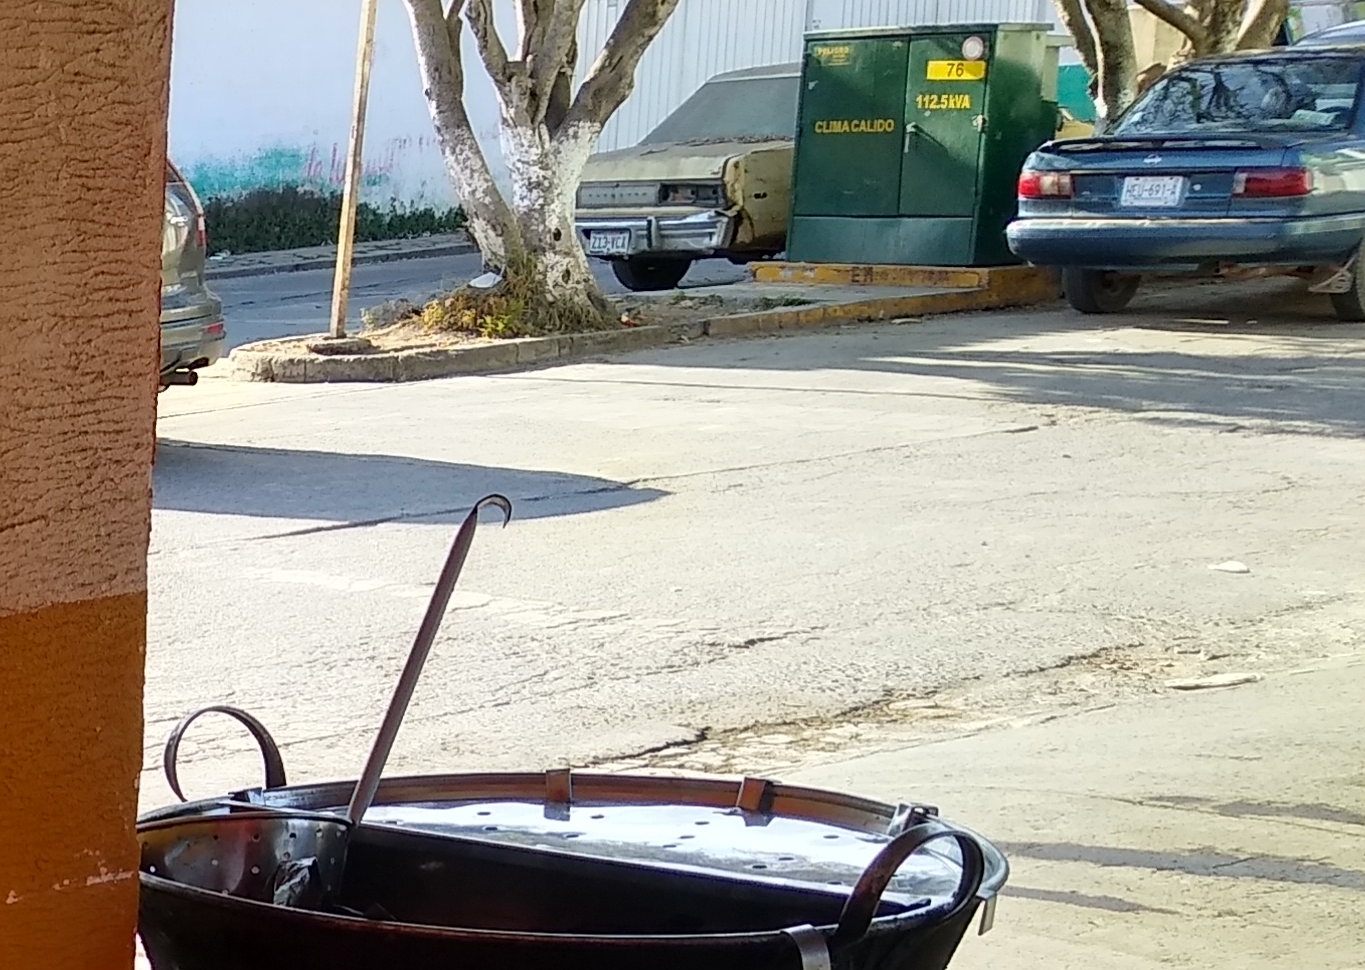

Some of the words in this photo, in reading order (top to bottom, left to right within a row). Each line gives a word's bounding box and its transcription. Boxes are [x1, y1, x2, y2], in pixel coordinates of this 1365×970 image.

[946, 63, 964, 77] 76
[815, 120, 849, 133] CLIMA
[851, 118, 895, 132] CALIDO
